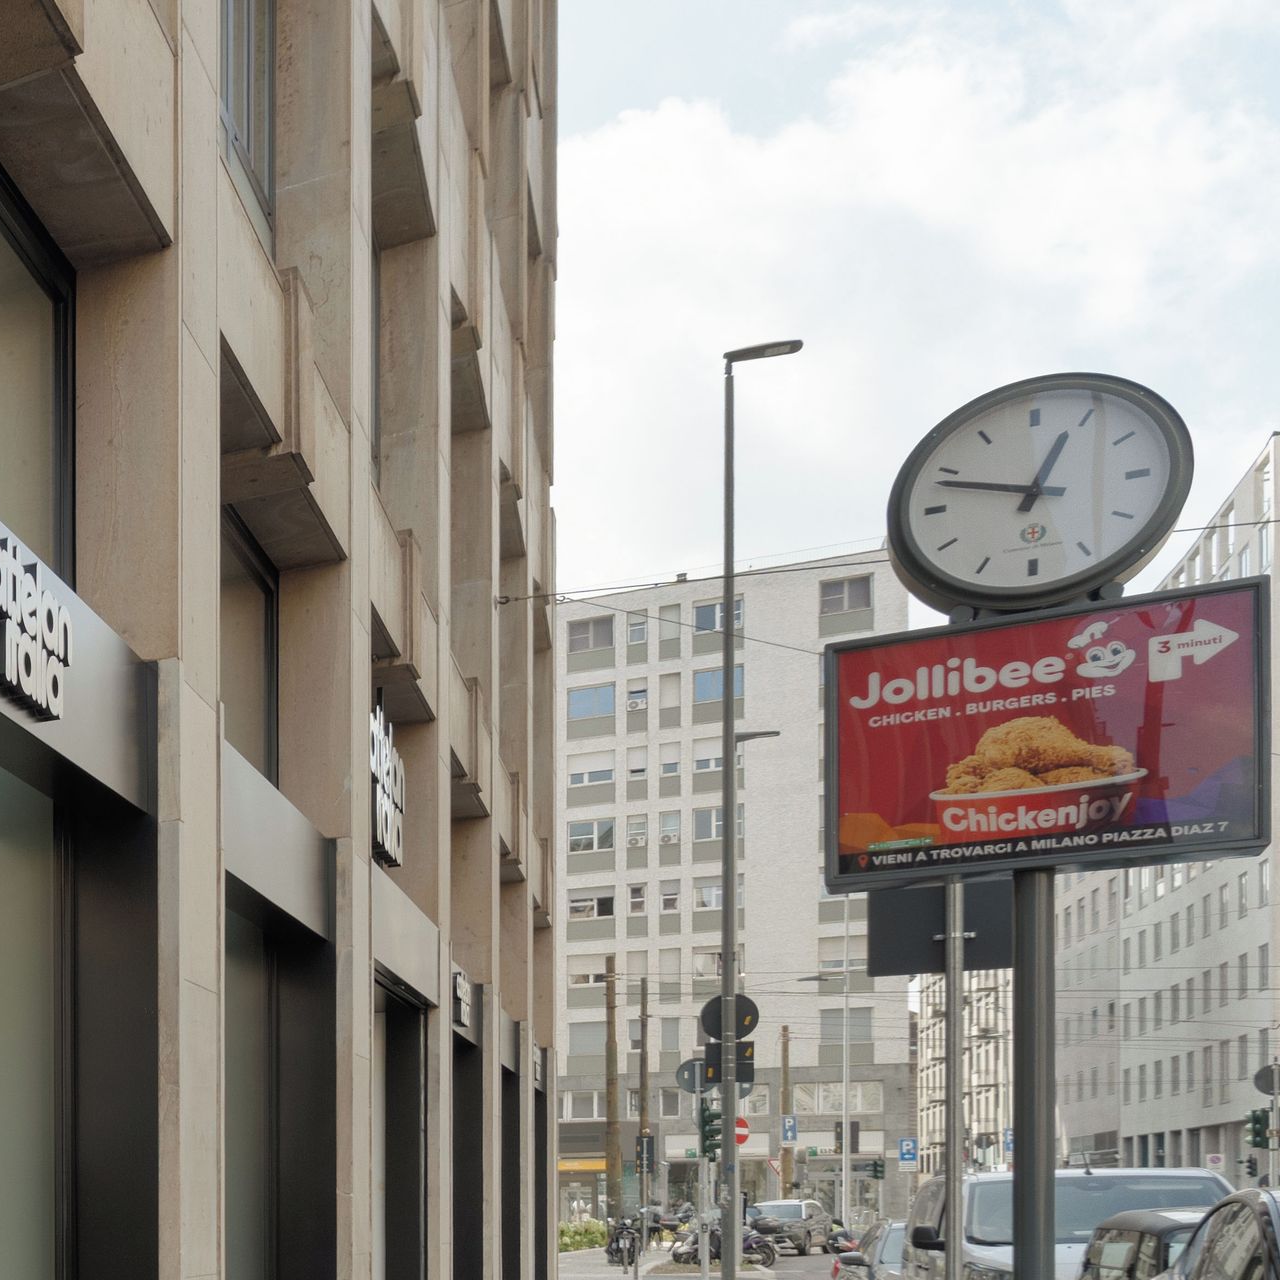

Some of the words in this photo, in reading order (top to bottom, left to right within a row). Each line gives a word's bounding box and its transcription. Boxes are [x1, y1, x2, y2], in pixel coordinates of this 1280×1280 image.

[1157, 640, 1171, 654] 3
[1177, 635, 1223, 650] minuti
[849, 656, 1066, 709] Jollibee
[868, 706, 951, 728] CHICKEN
[966, 692, 1057, 715] BURGERS
[1072, 684, 1117, 701] PIES
[943, 792, 1133, 832] Chickenjoy
[872, 853, 912, 866] VIENI
[915, 850, 928, 862] A
[930, 843, 1012, 860] TROVARCI
[1015, 841, 1028, 852] A
[1031, 834, 1098, 850] MILANO
[1102, 827, 1168, 843] PIAZZA
[1171, 822, 1214, 836] DIAZ
[1218, 821, 1229, 832] 7
[785, 1118, 793, 1129] P
[902, 1141, 913, 1153] P
